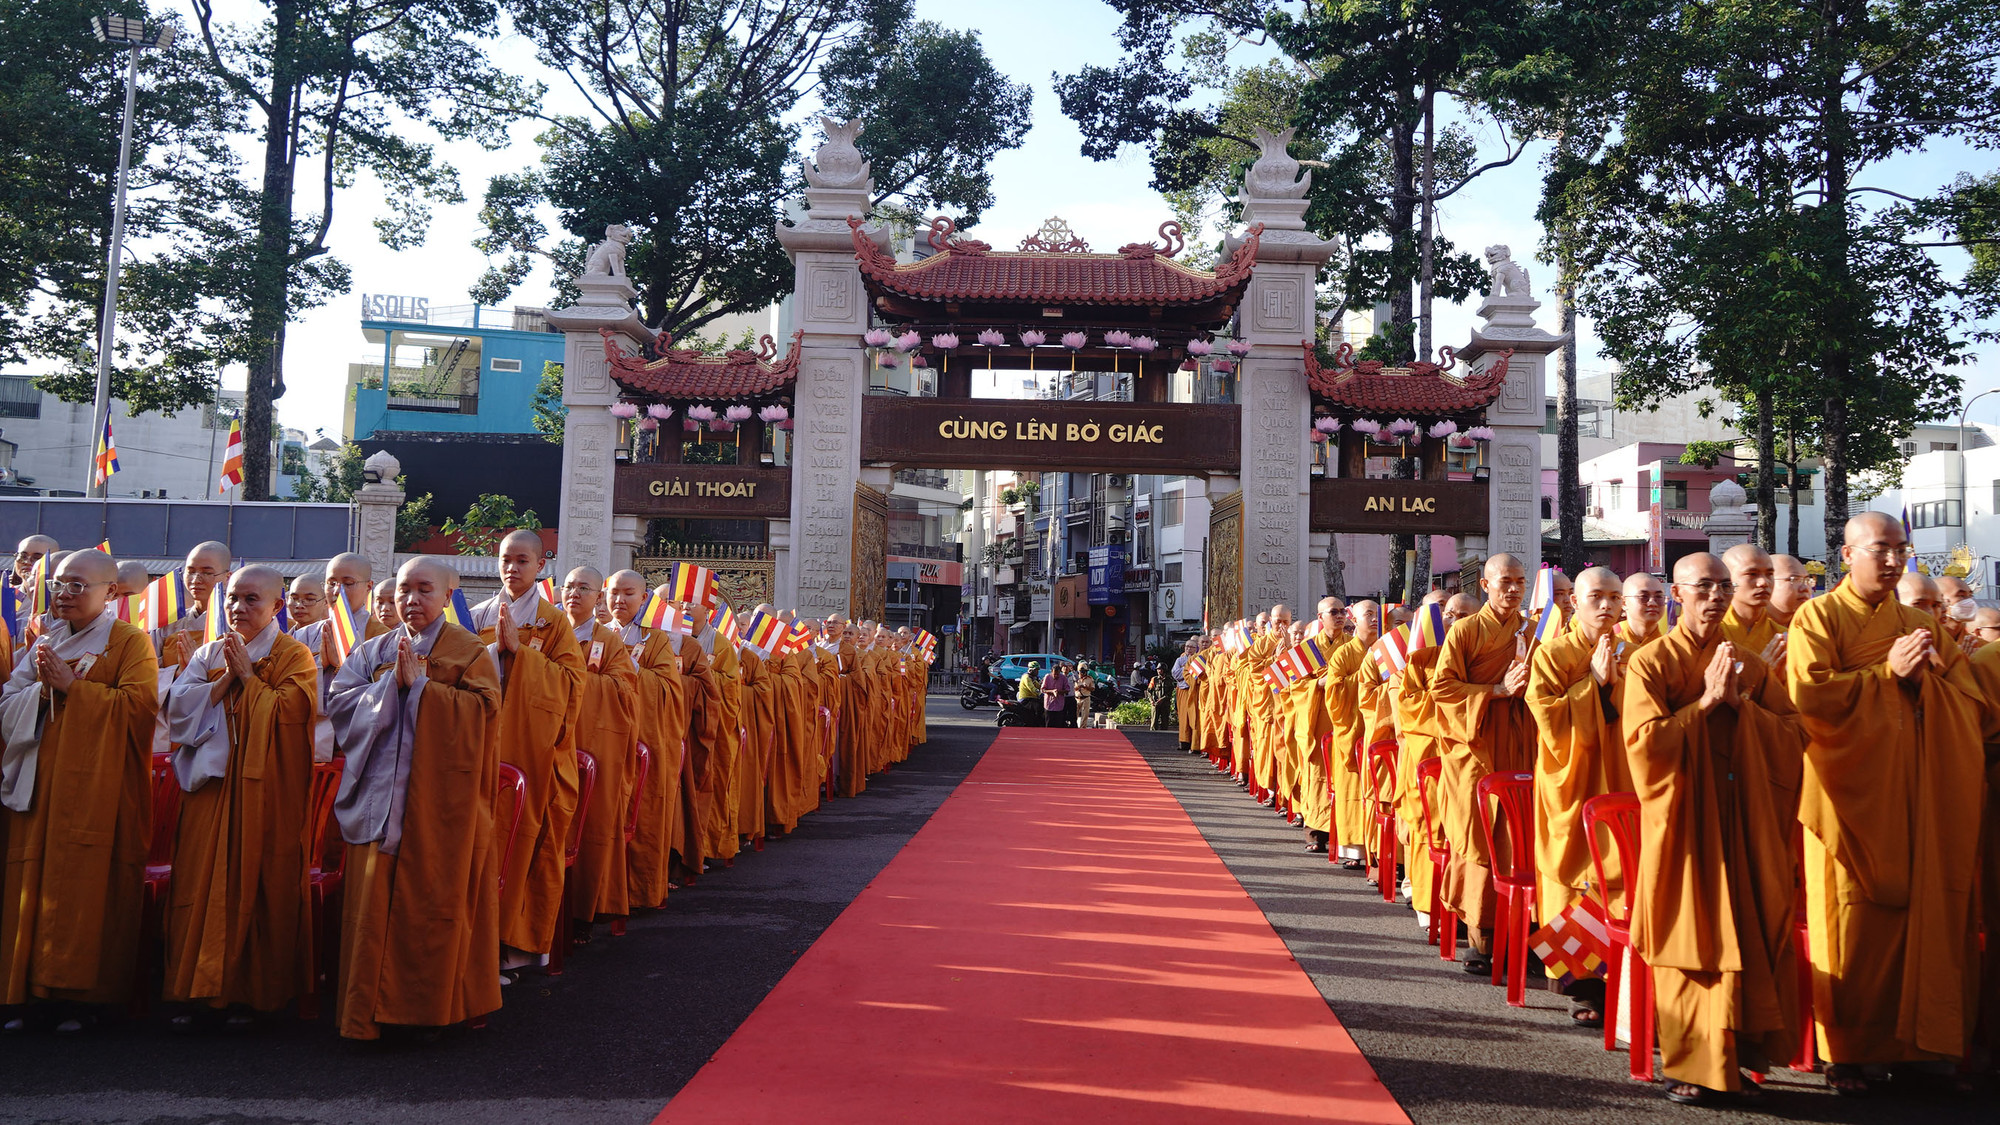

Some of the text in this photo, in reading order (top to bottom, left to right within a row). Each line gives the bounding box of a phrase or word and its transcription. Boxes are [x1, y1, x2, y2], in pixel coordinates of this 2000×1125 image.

[371, 293, 429, 320] SOLIS
[813, 402, 846, 419] Việt
[810, 420, 847, 434] Nam
[938, 415, 1164, 444] CÙNG LÊN BỜ GIÁC
[1259, 412, 1294, 431] Quốc
[648, 476, 757, 498] GIẢI THOÁT
[1364, 496, 1436, 516] AN LẠC
[805, 522, 844, 539] Sạch
[1258, 515, 1291, 533] Sáng
[1257, 550, 1291, 565] Chân
